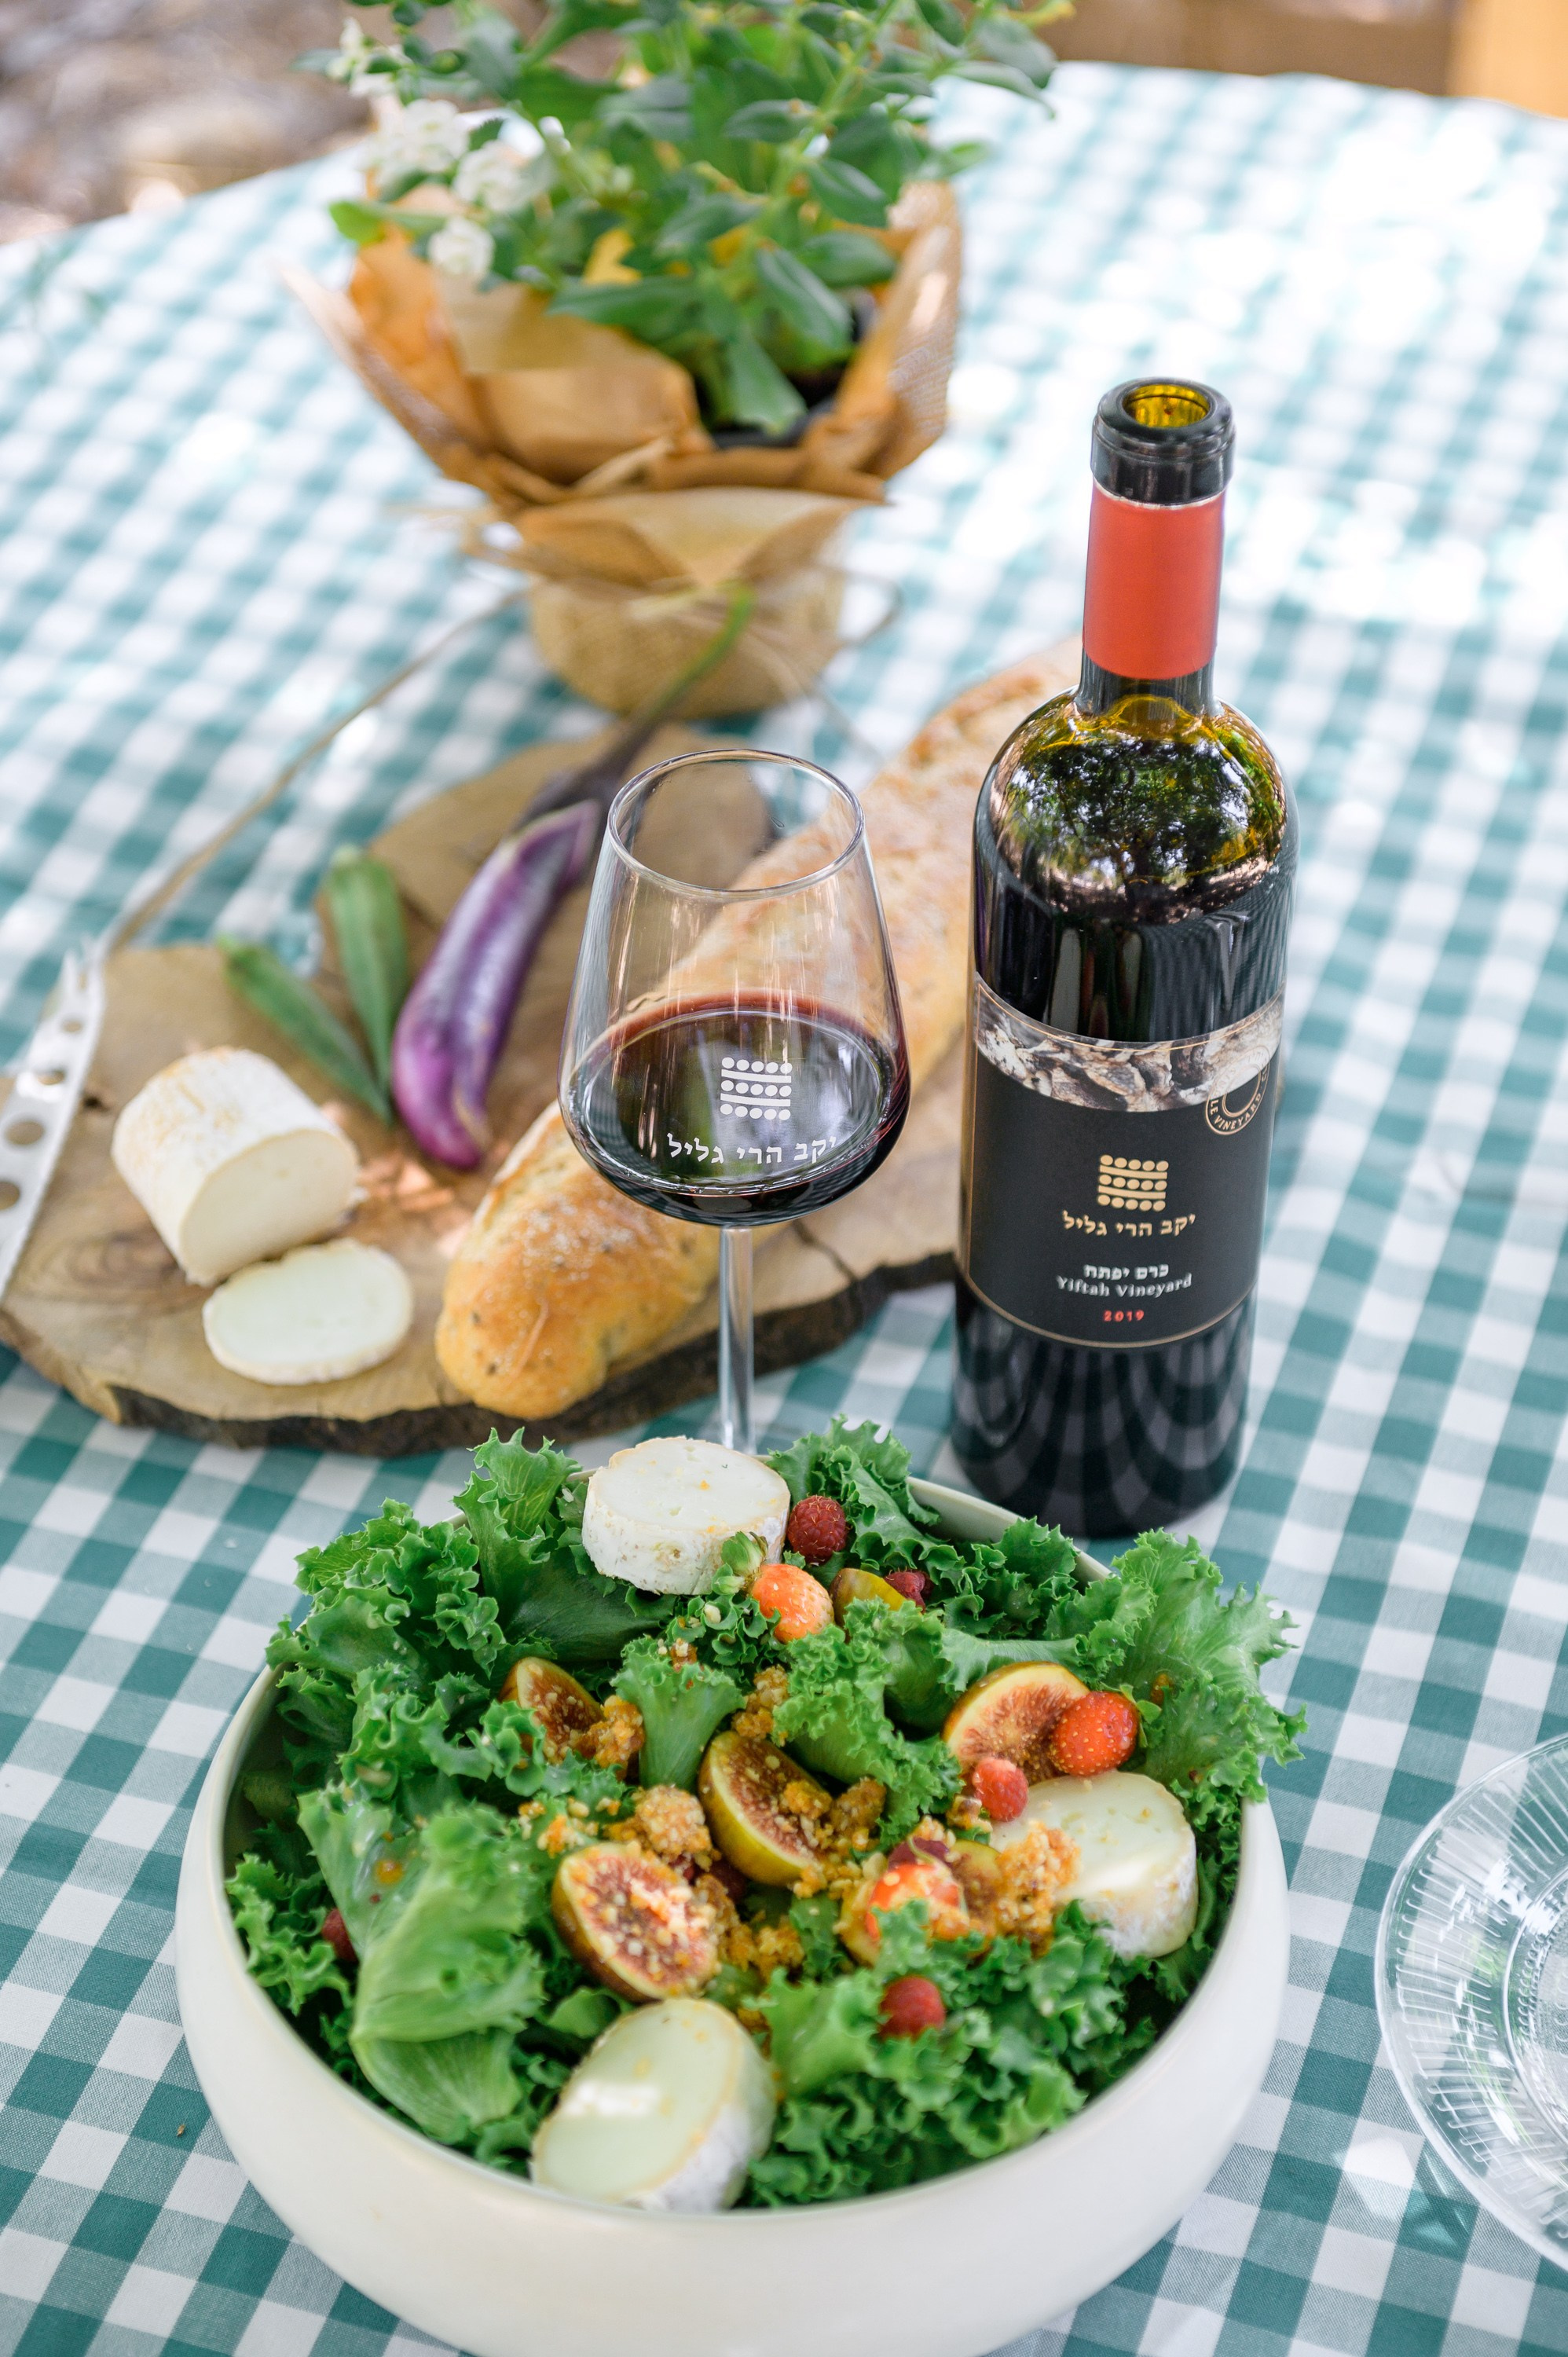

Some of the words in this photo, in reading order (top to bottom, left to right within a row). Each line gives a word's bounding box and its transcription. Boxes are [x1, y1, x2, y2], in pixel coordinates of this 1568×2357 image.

[1214, 1093, 1262, 1131] VINEYARD
[667, 1132, 724, 1164] גליל
[736, 1146, 782, 1164] הרי
[793, 1136, 837, 1164] יקב
[1062, 1209, 1108, 1237] גליל
[1115, 1222, 1152, 1237] הרי
[1160, 1213, 1196, 1237] יקב
[1083, 1263, 1130, 1281] יפתח
[1134, 1263, 1169, 1281] כרם
[1056, 1274, 1110, 1297] Yiftah
[1115, 1271, 1192, 1299] Vineyard
[1103, 1309, 1145, 1322] 2019
